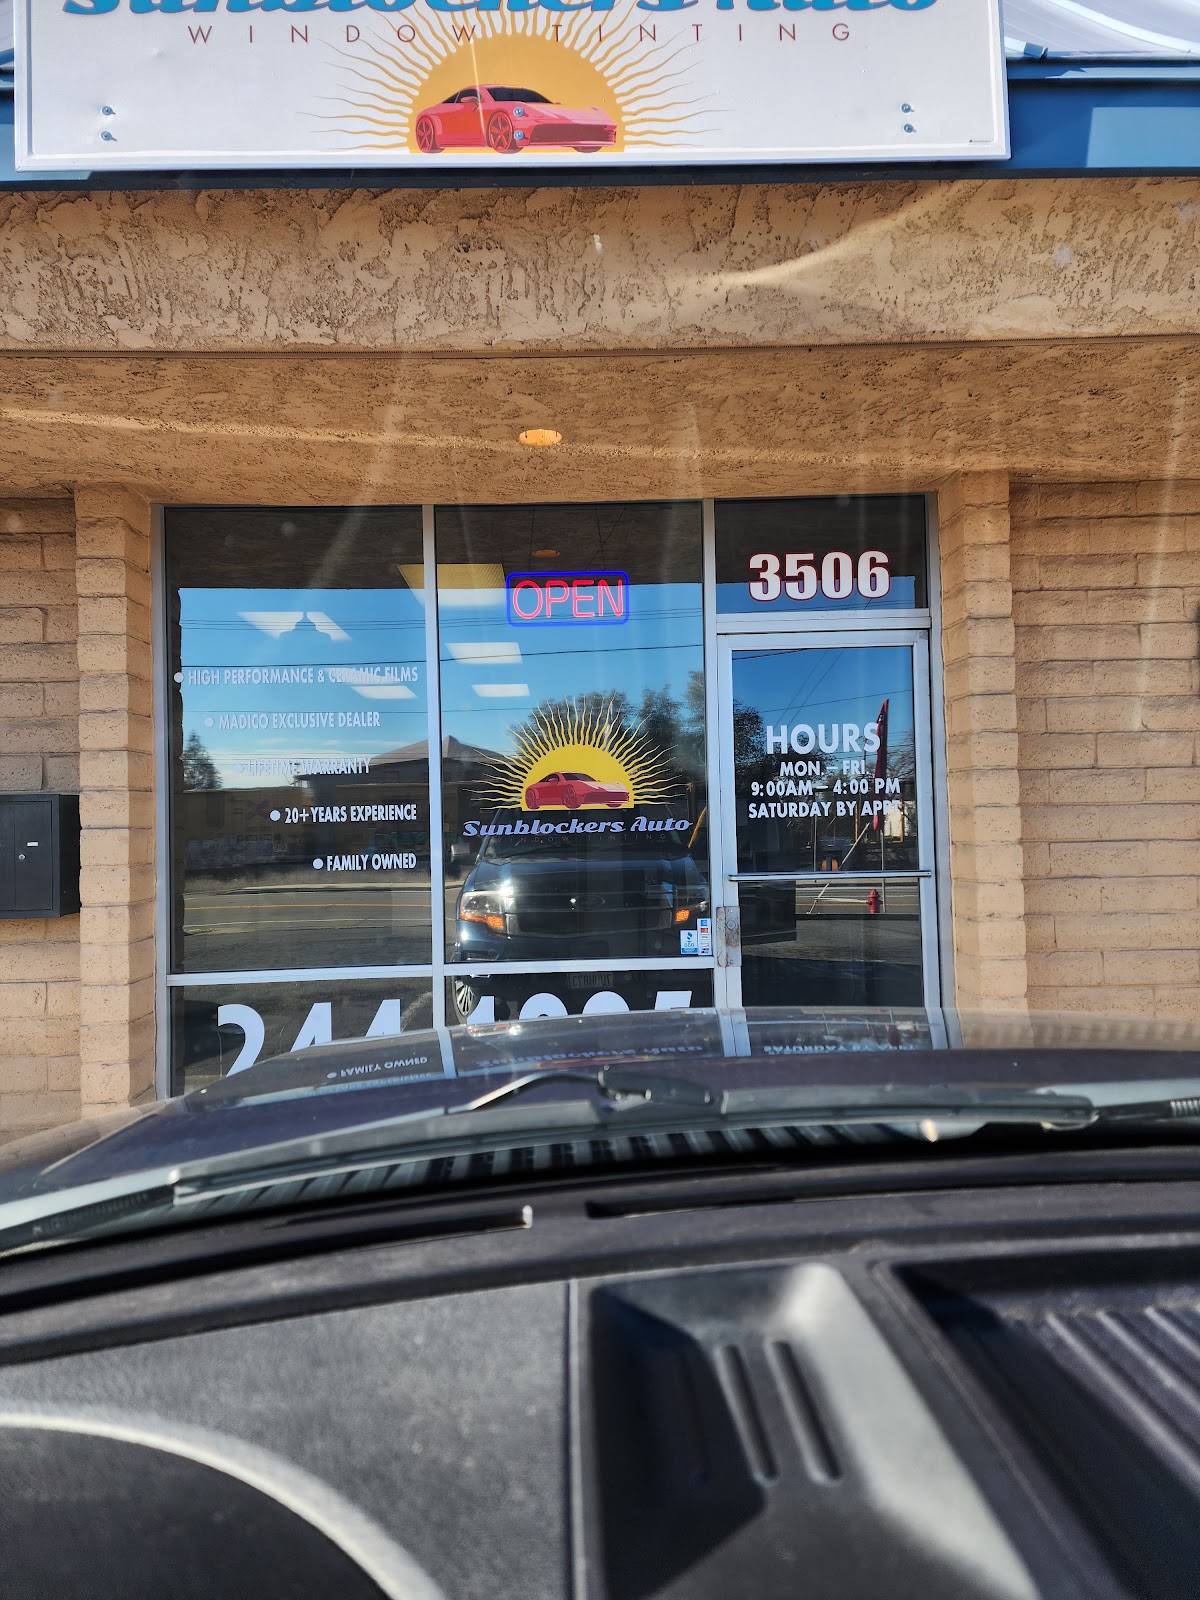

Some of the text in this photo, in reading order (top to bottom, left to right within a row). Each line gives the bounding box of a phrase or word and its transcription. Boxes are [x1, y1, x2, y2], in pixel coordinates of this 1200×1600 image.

[187, 22, 851, 44] WINDOW TINTING
[748, 550, 891, 602] 3506
[512, 578, 624, 620] OPEN
[188, 666, 419, 685] HIGH PERFORMANCE & CERAMIC FILMS
[219, 711, 381, 730] MADICO EXCLUSIVE DEALER
[766, 723, 881, 755] HOURS
[247, 757, 371, 776] LIFETIME WARRANTY
[779, 760, 825, 777] MON.
[750, 779, 813, 797] 9:00AM
[833, 778, 869, 795] 4:00
[874, 777, 901, 794] PM
[350, 803, 417, 822] EXPERIENCE
[748, 801, 832, 819] SATURDAY
[836, 800, 857, 817] BY
[462, 815, 694, 837] Sunblockers Auto
[493, 836, 571, 844] WINDOW
[326, 852, 417, 872] FAMILY OWNED
